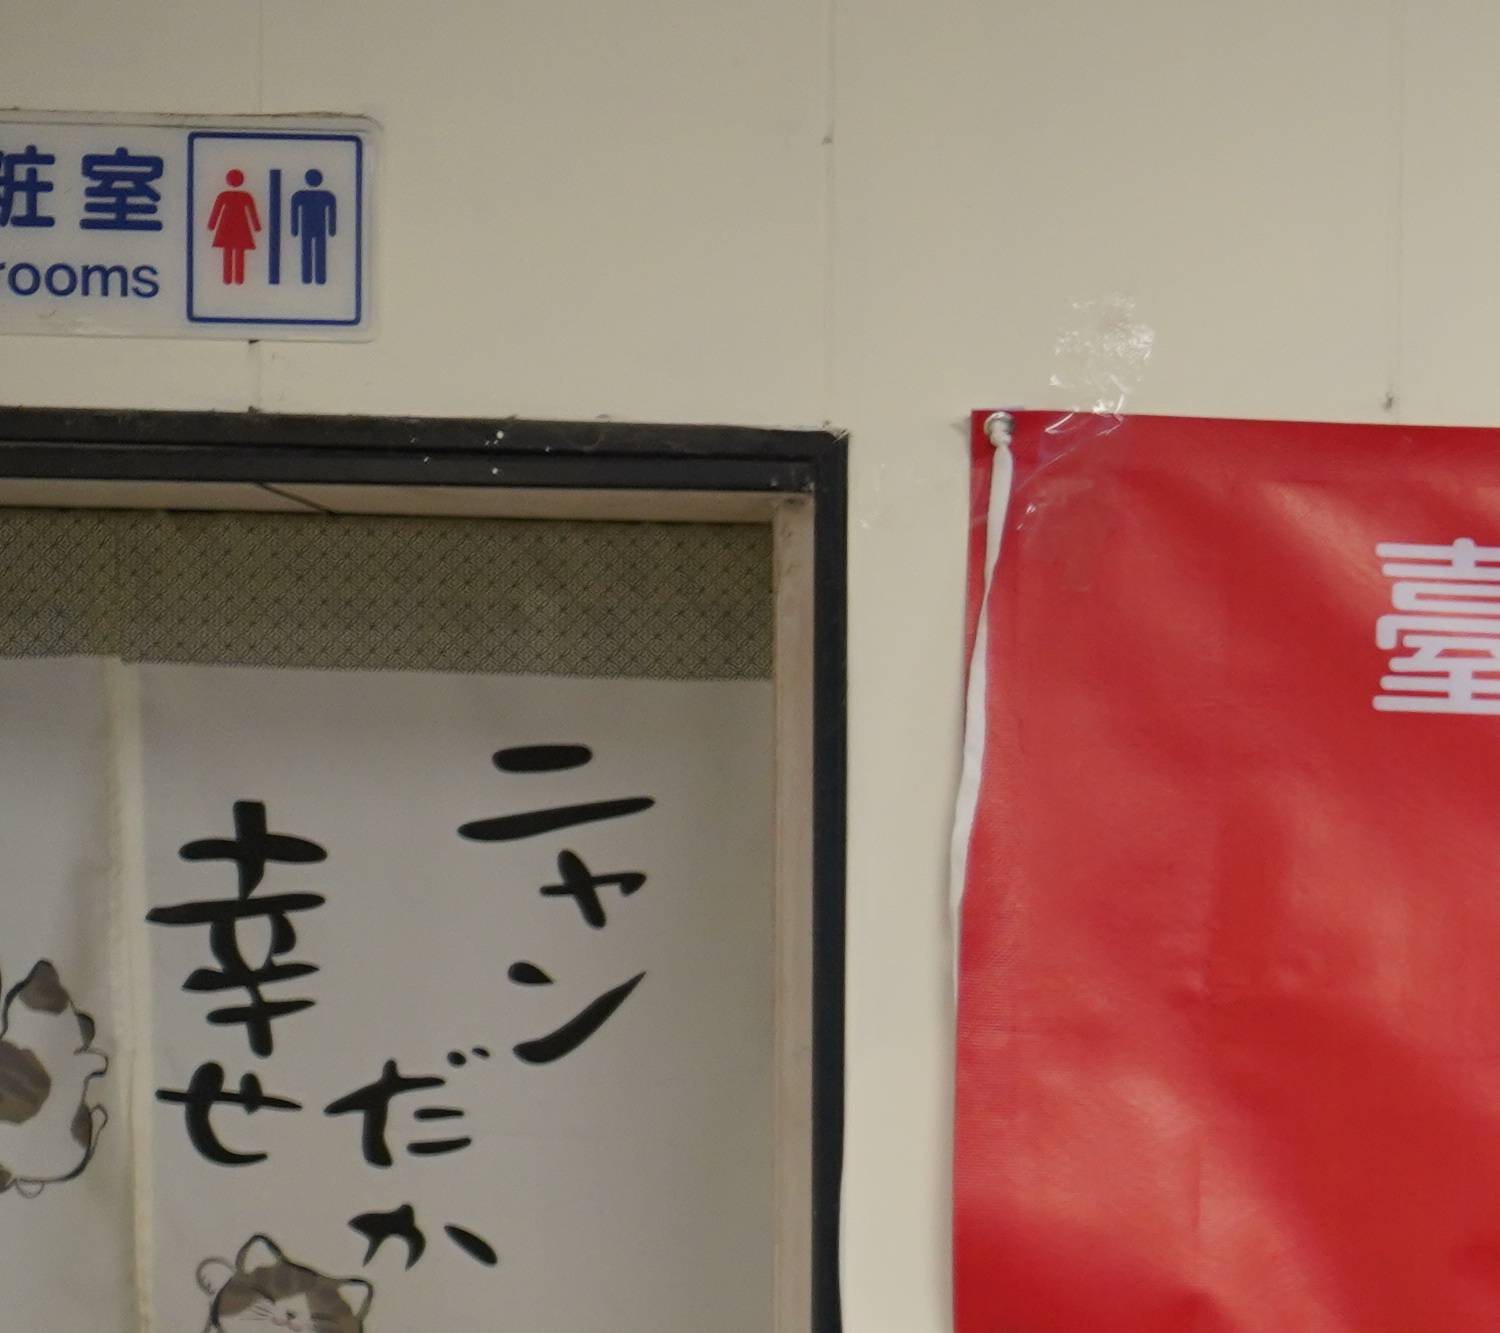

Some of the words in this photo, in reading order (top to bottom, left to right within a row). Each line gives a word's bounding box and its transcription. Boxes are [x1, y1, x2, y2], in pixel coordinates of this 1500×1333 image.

[0, 261, 162, 299] ooms
[146, 800, 328, 1167] 幸せ
[457, 743, 657, 1066] ニャン
